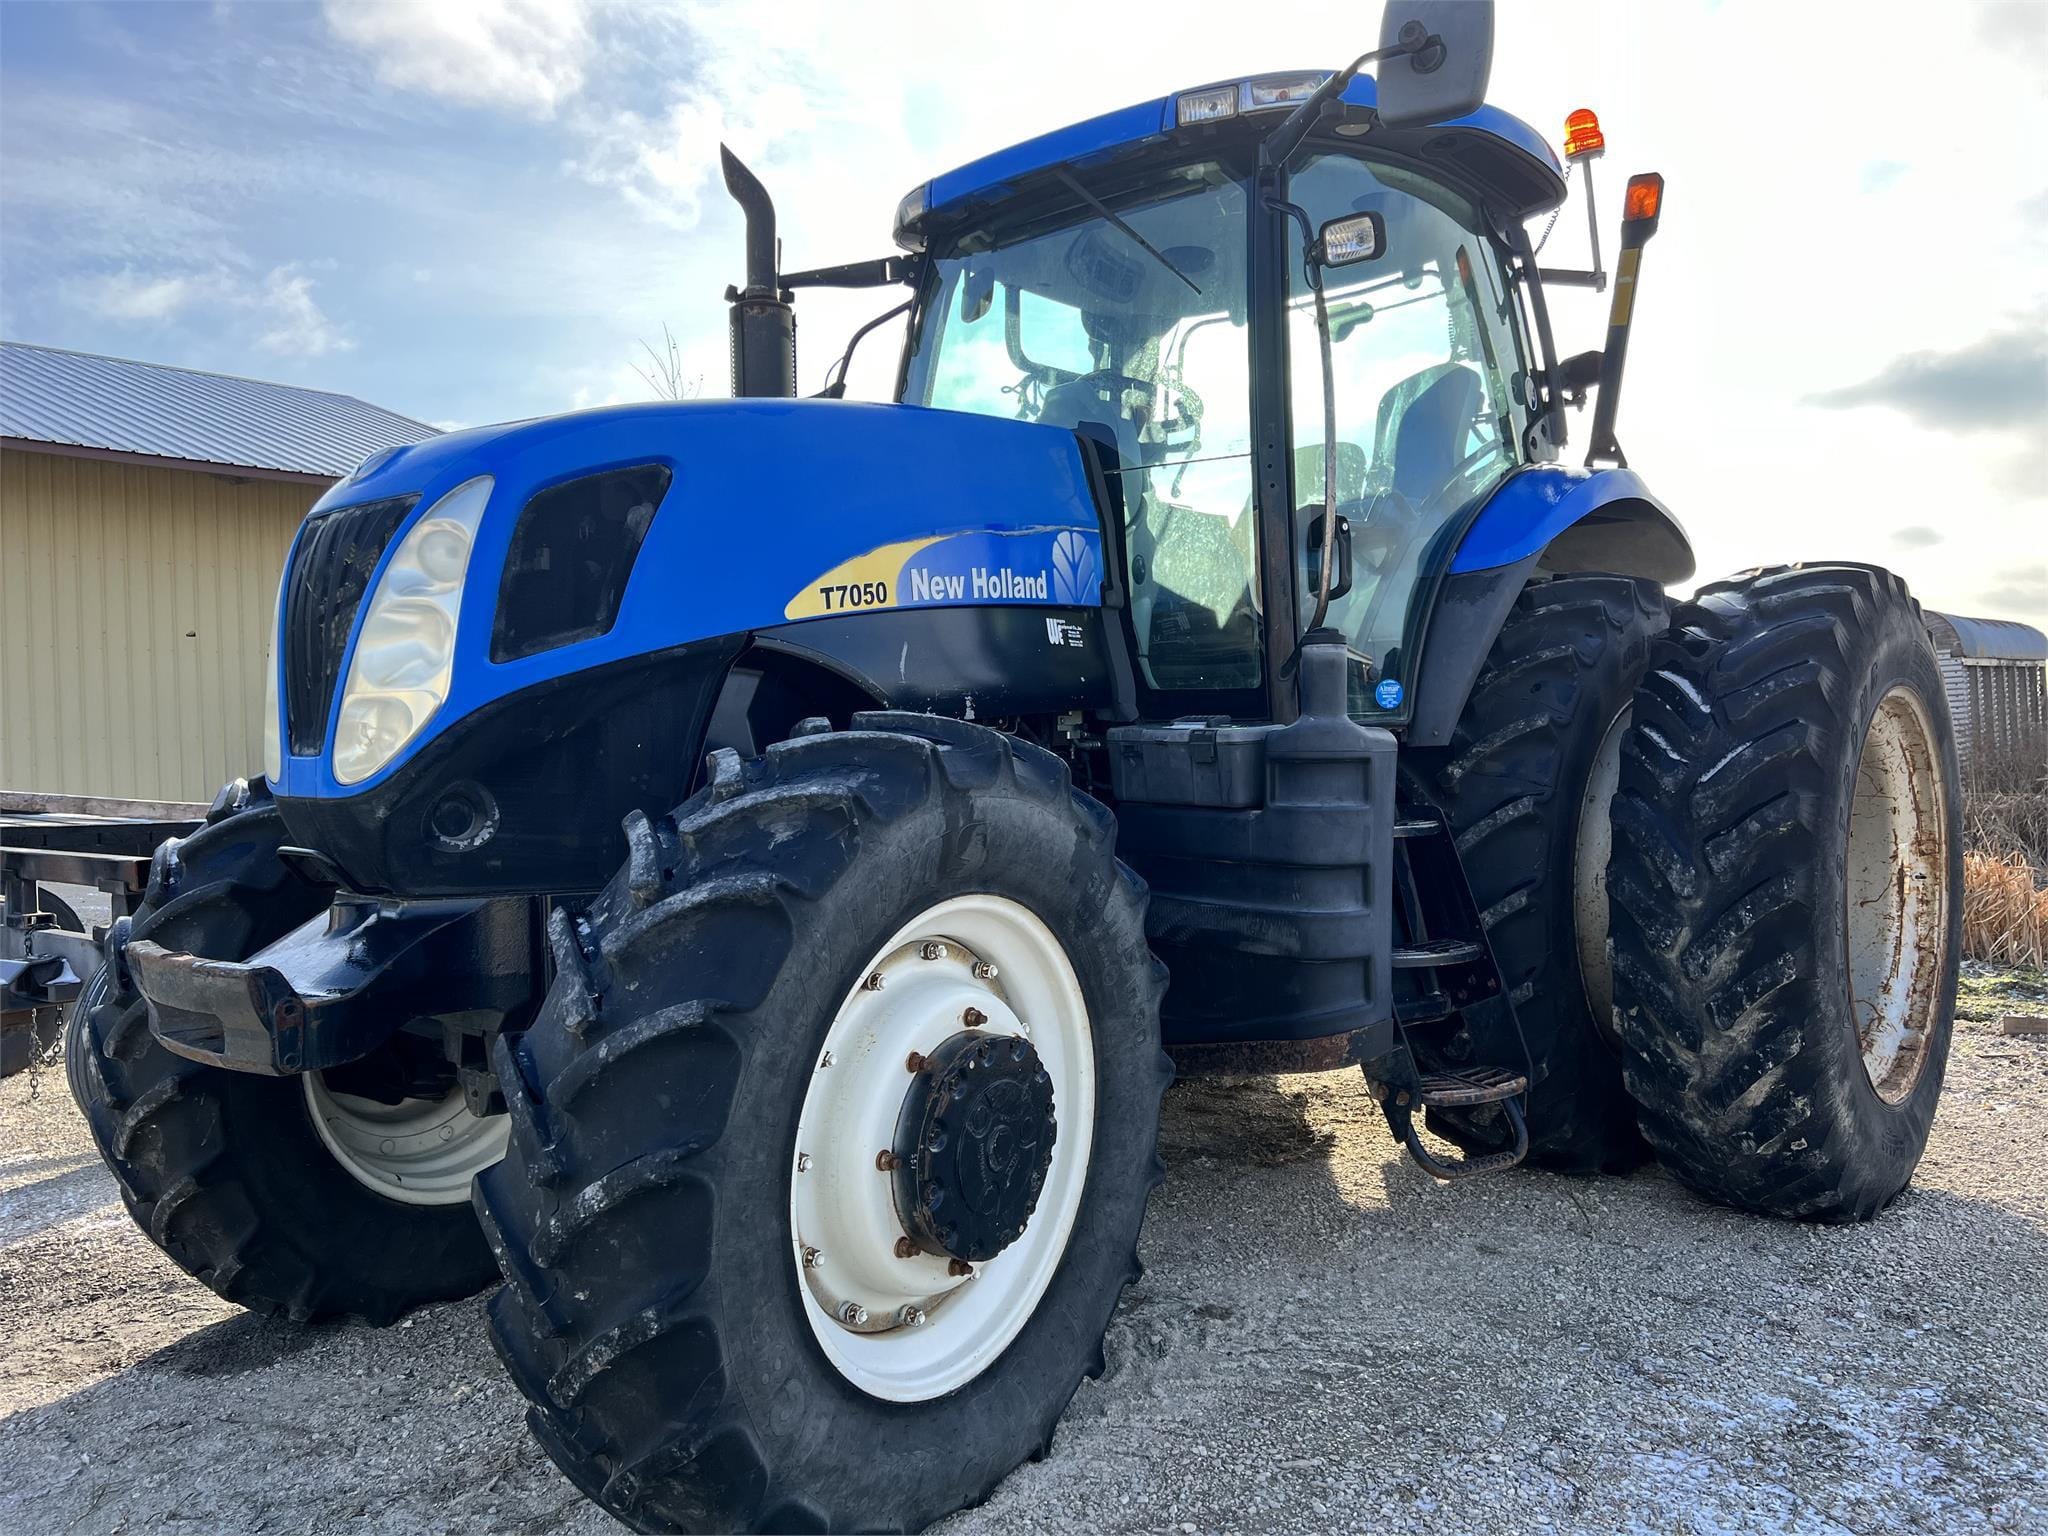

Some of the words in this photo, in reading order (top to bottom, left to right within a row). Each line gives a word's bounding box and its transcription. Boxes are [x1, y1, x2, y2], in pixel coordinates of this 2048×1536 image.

[820, 581, 888, 610] T7050
[910, 568, 965, 601] New
[971, 567, 1048, 600] Holland
